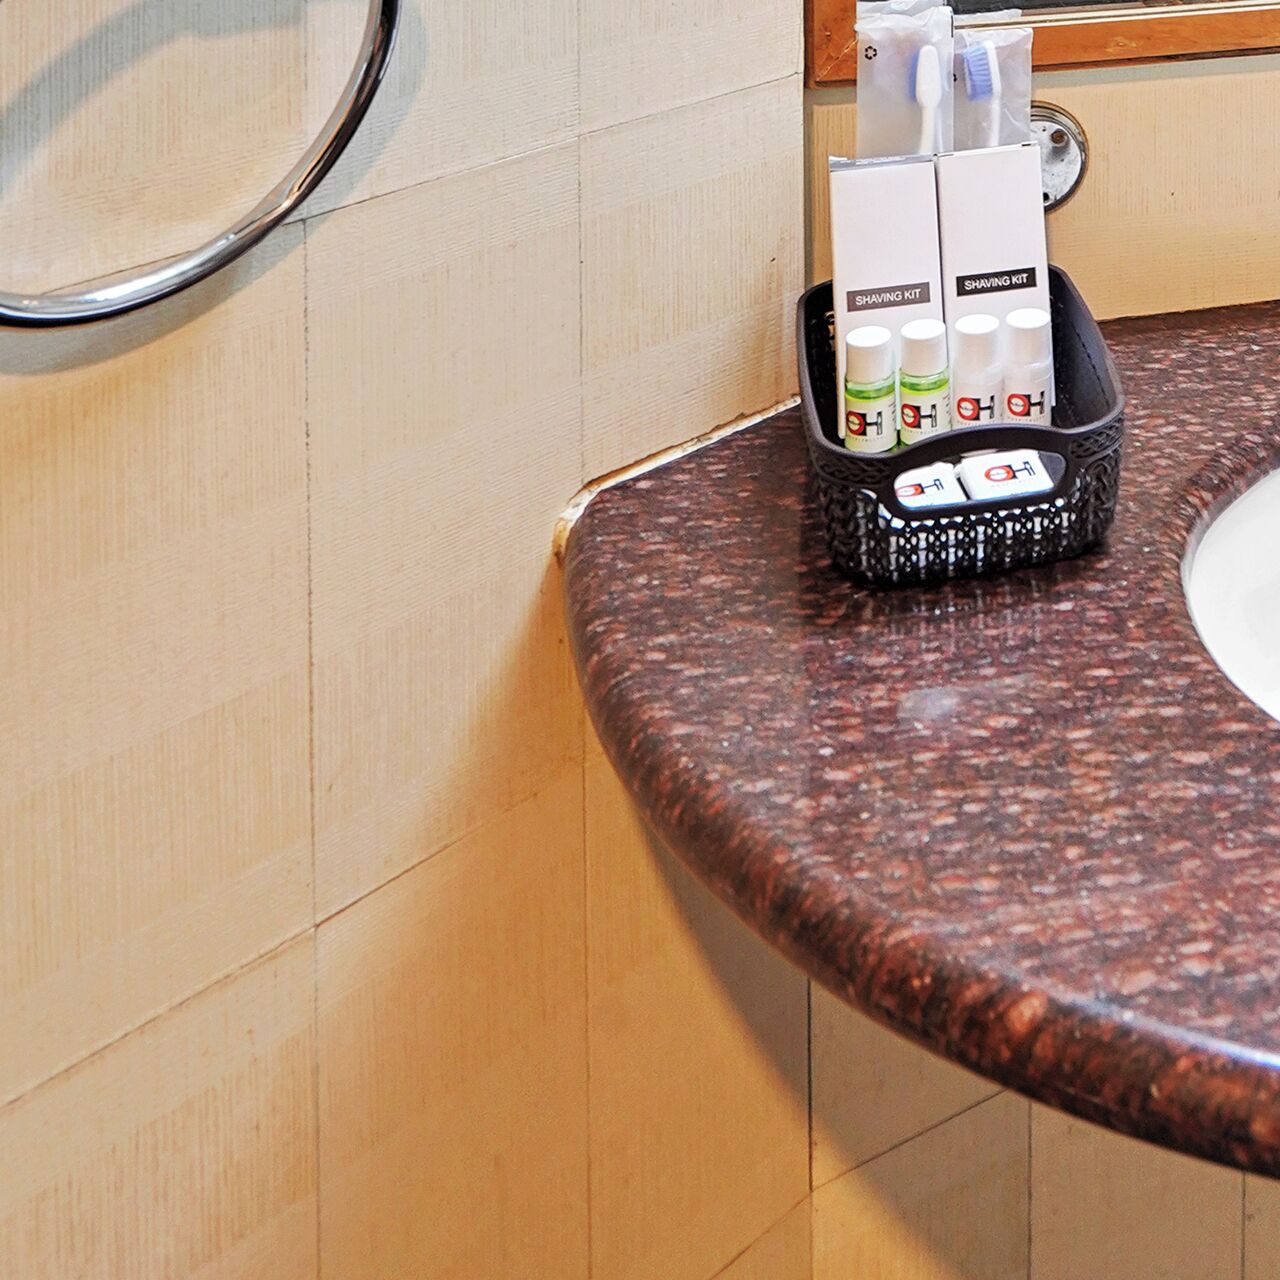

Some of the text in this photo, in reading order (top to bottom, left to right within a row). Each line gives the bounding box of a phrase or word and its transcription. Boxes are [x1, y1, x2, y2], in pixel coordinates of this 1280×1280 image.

[964, 273, 1028, 291] SHAVING KIT
[855, 288, 921, 306] SHAVING KIT
